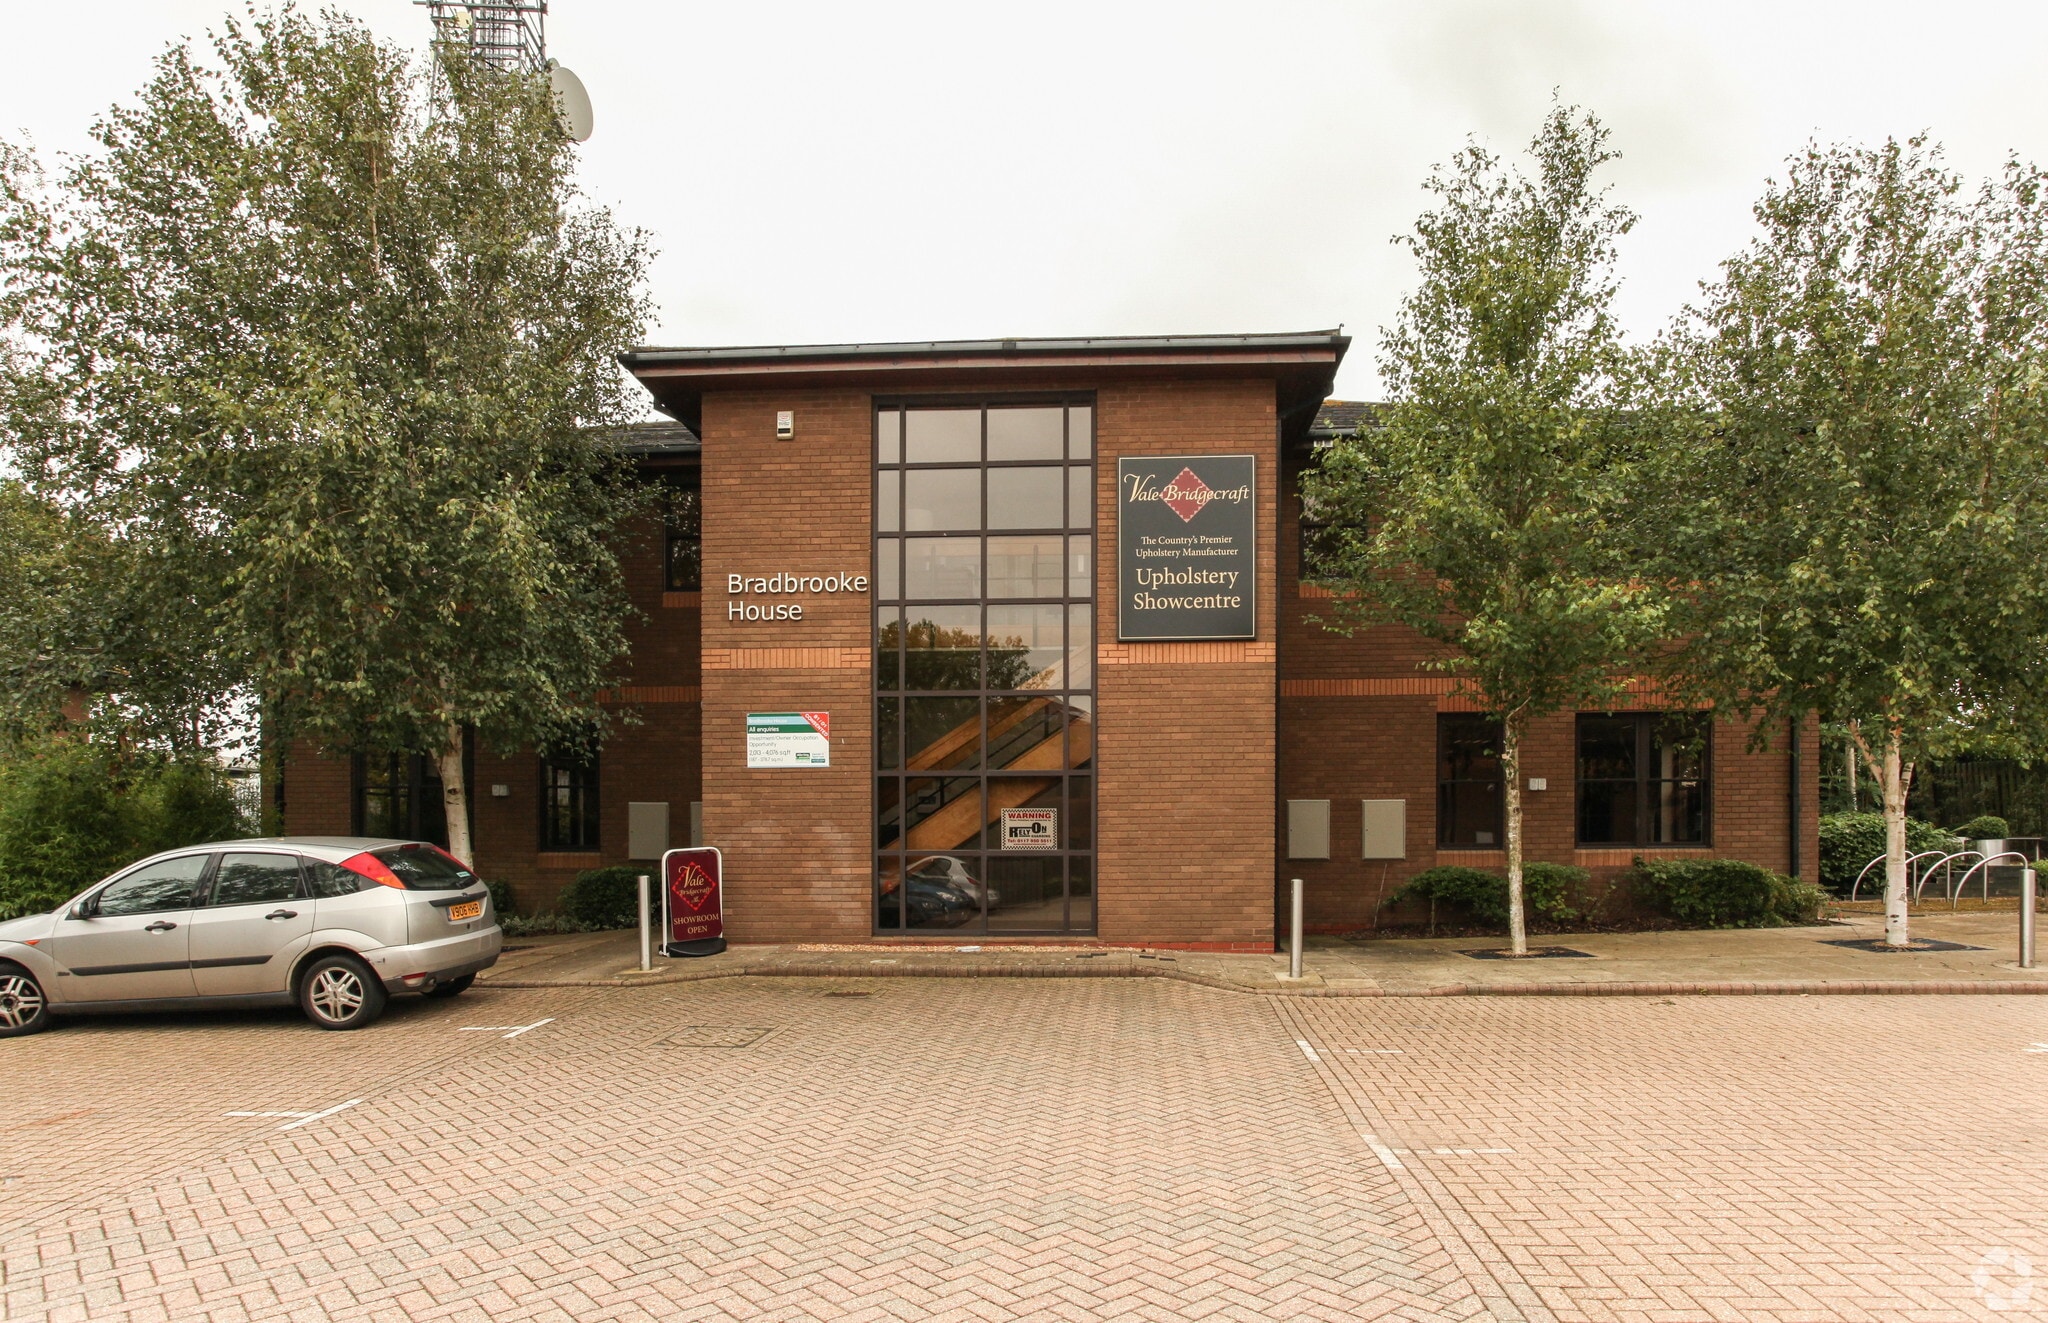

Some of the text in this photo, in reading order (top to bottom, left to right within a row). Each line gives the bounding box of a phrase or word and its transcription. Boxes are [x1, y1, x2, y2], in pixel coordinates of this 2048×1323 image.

[1124, 473, 1249, 505] Vale Bridgecraft
[1140, 536, 1232, 546] The Country's Premier
[1135, 548, 1239, 559] Upholstery Manufacturer
[728, 572, 868, 593] Bradbrooke
[1136, 566, 1239, 590] Upholstery
[1133, 592, 1241, 610] Showcentre
[728, 601, 802, 621] House
[678, 865, 705, 888] Vale
[673, 913, 720, 925] SHOWROOM
[687, 925, 708, 934] OPEN
